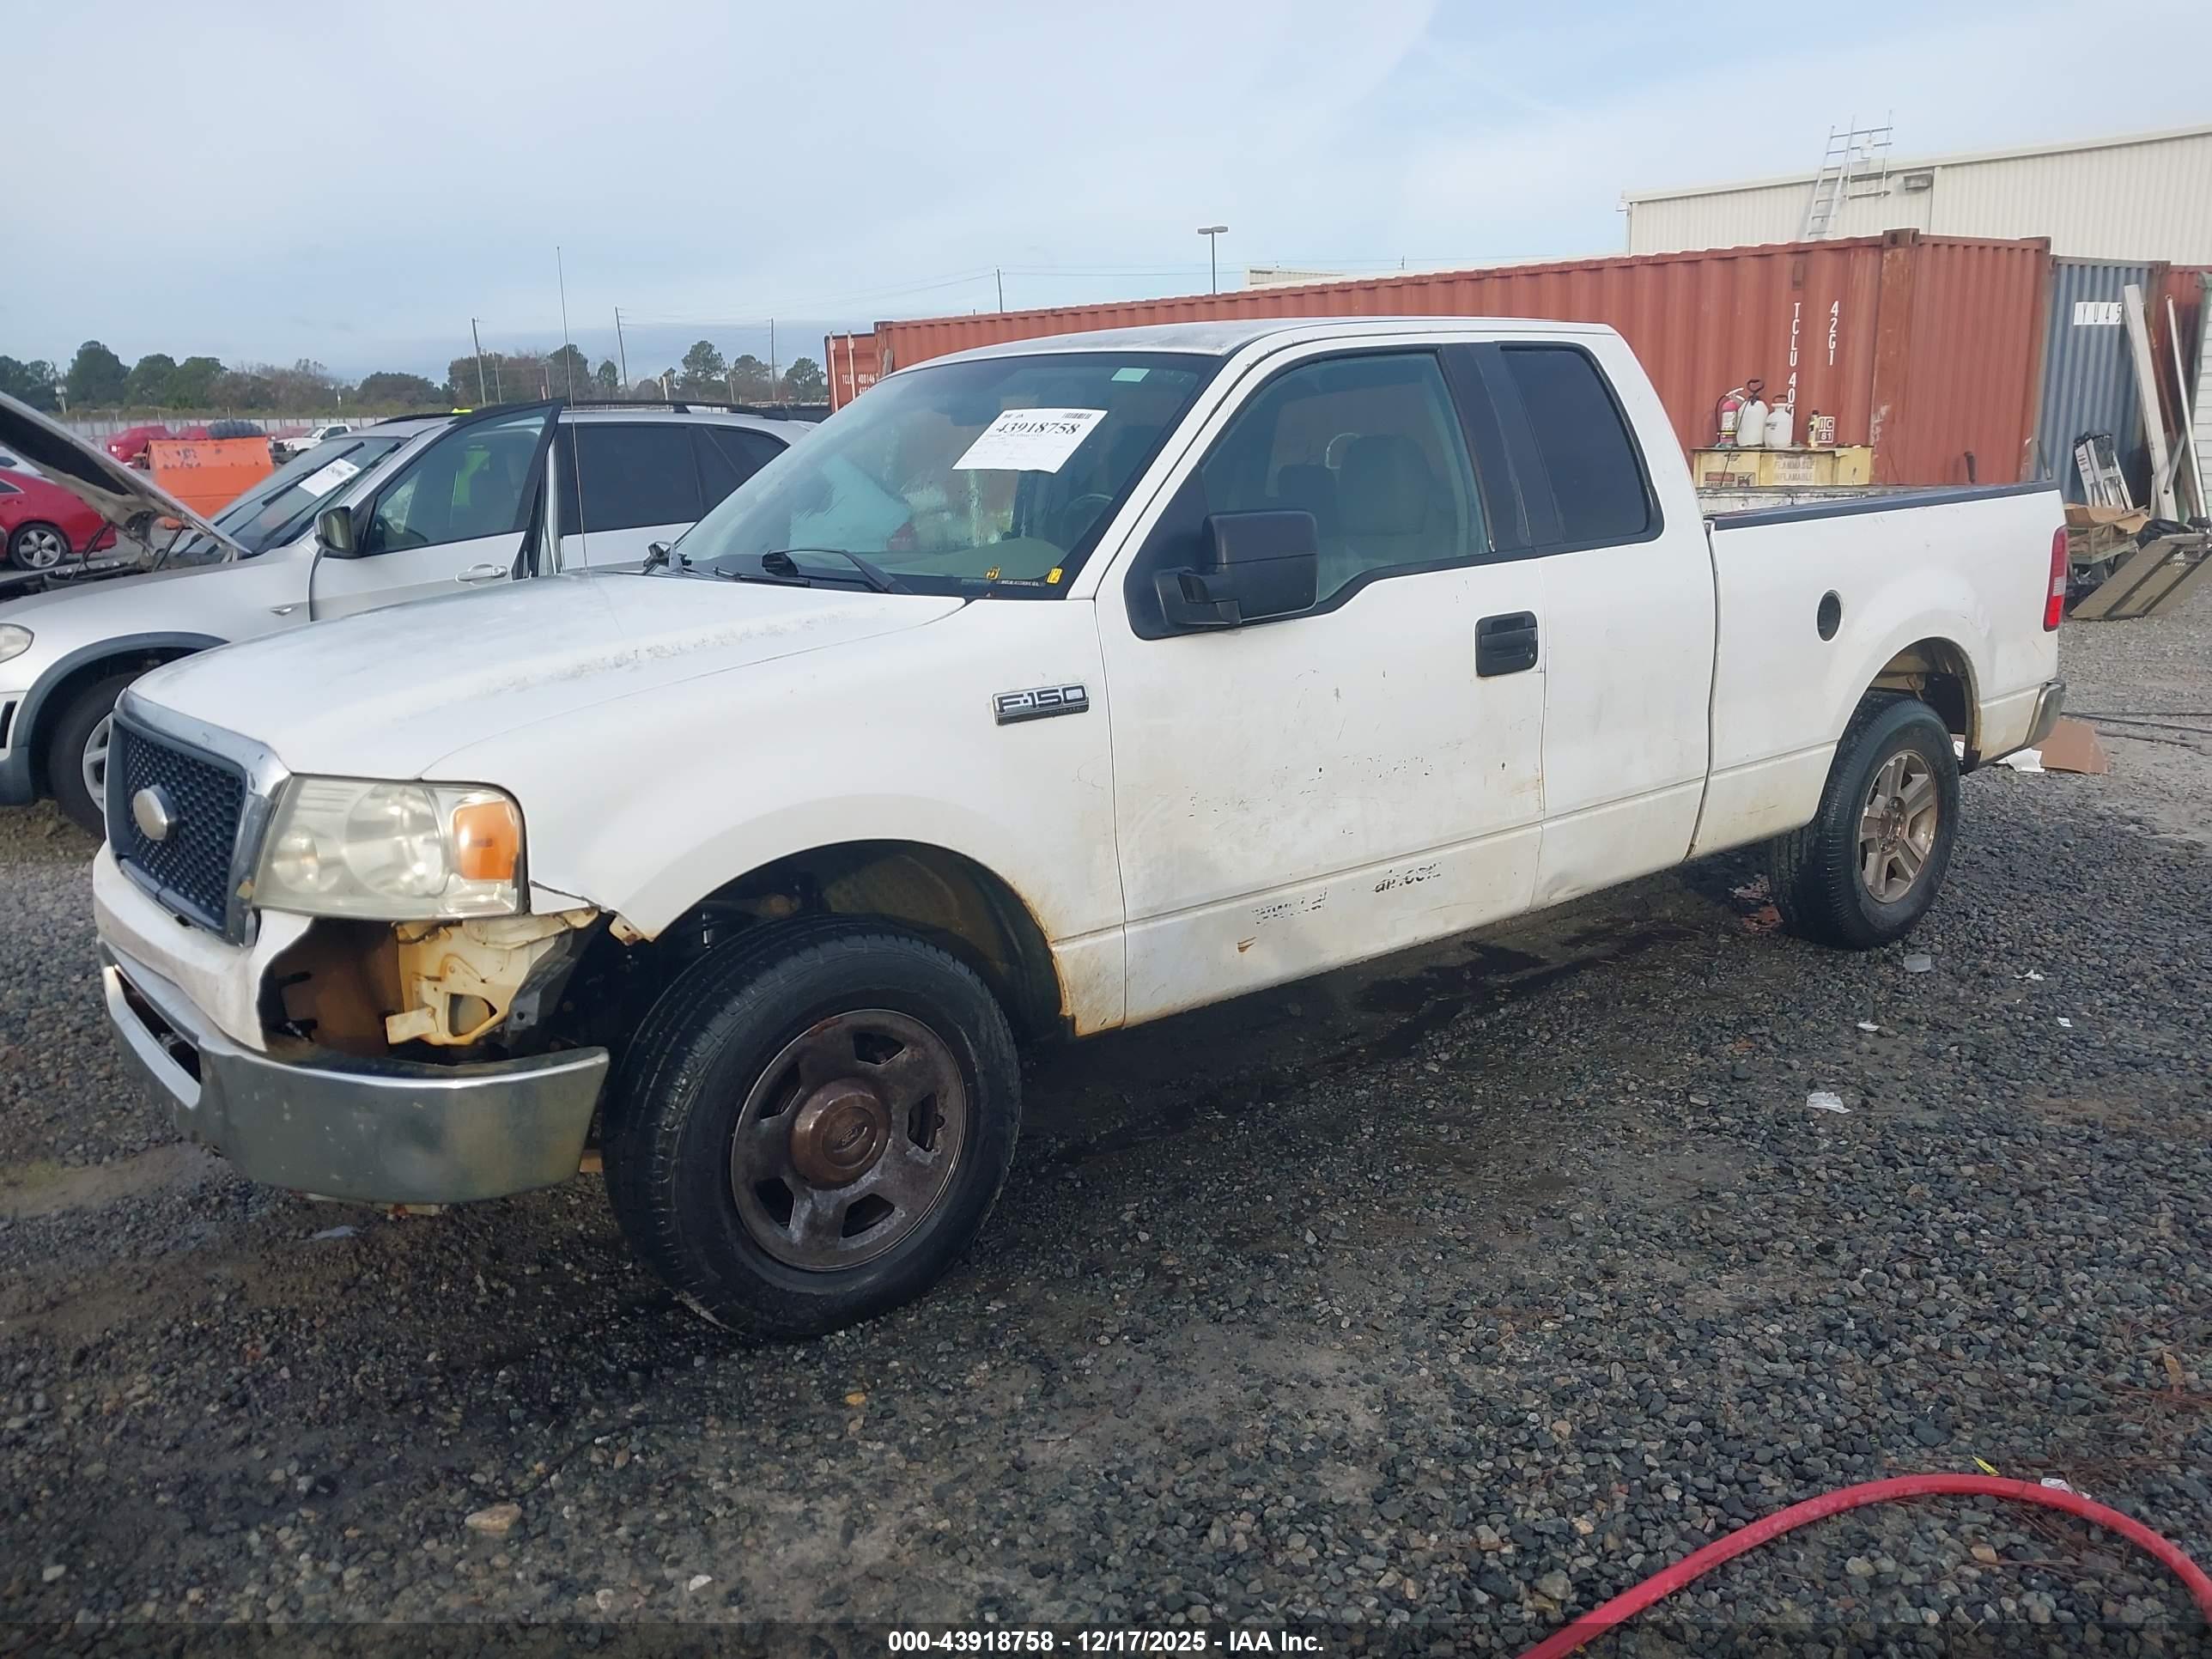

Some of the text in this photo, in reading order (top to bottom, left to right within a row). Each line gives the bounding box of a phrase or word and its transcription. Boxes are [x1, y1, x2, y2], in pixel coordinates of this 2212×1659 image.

[1790, 302, 1801, 367] TCLU
[1828, 301, 1839, 366] 42G1
[996, 422, 1081, 434] 43918758
[997, 684, 1087, 714] F-150
